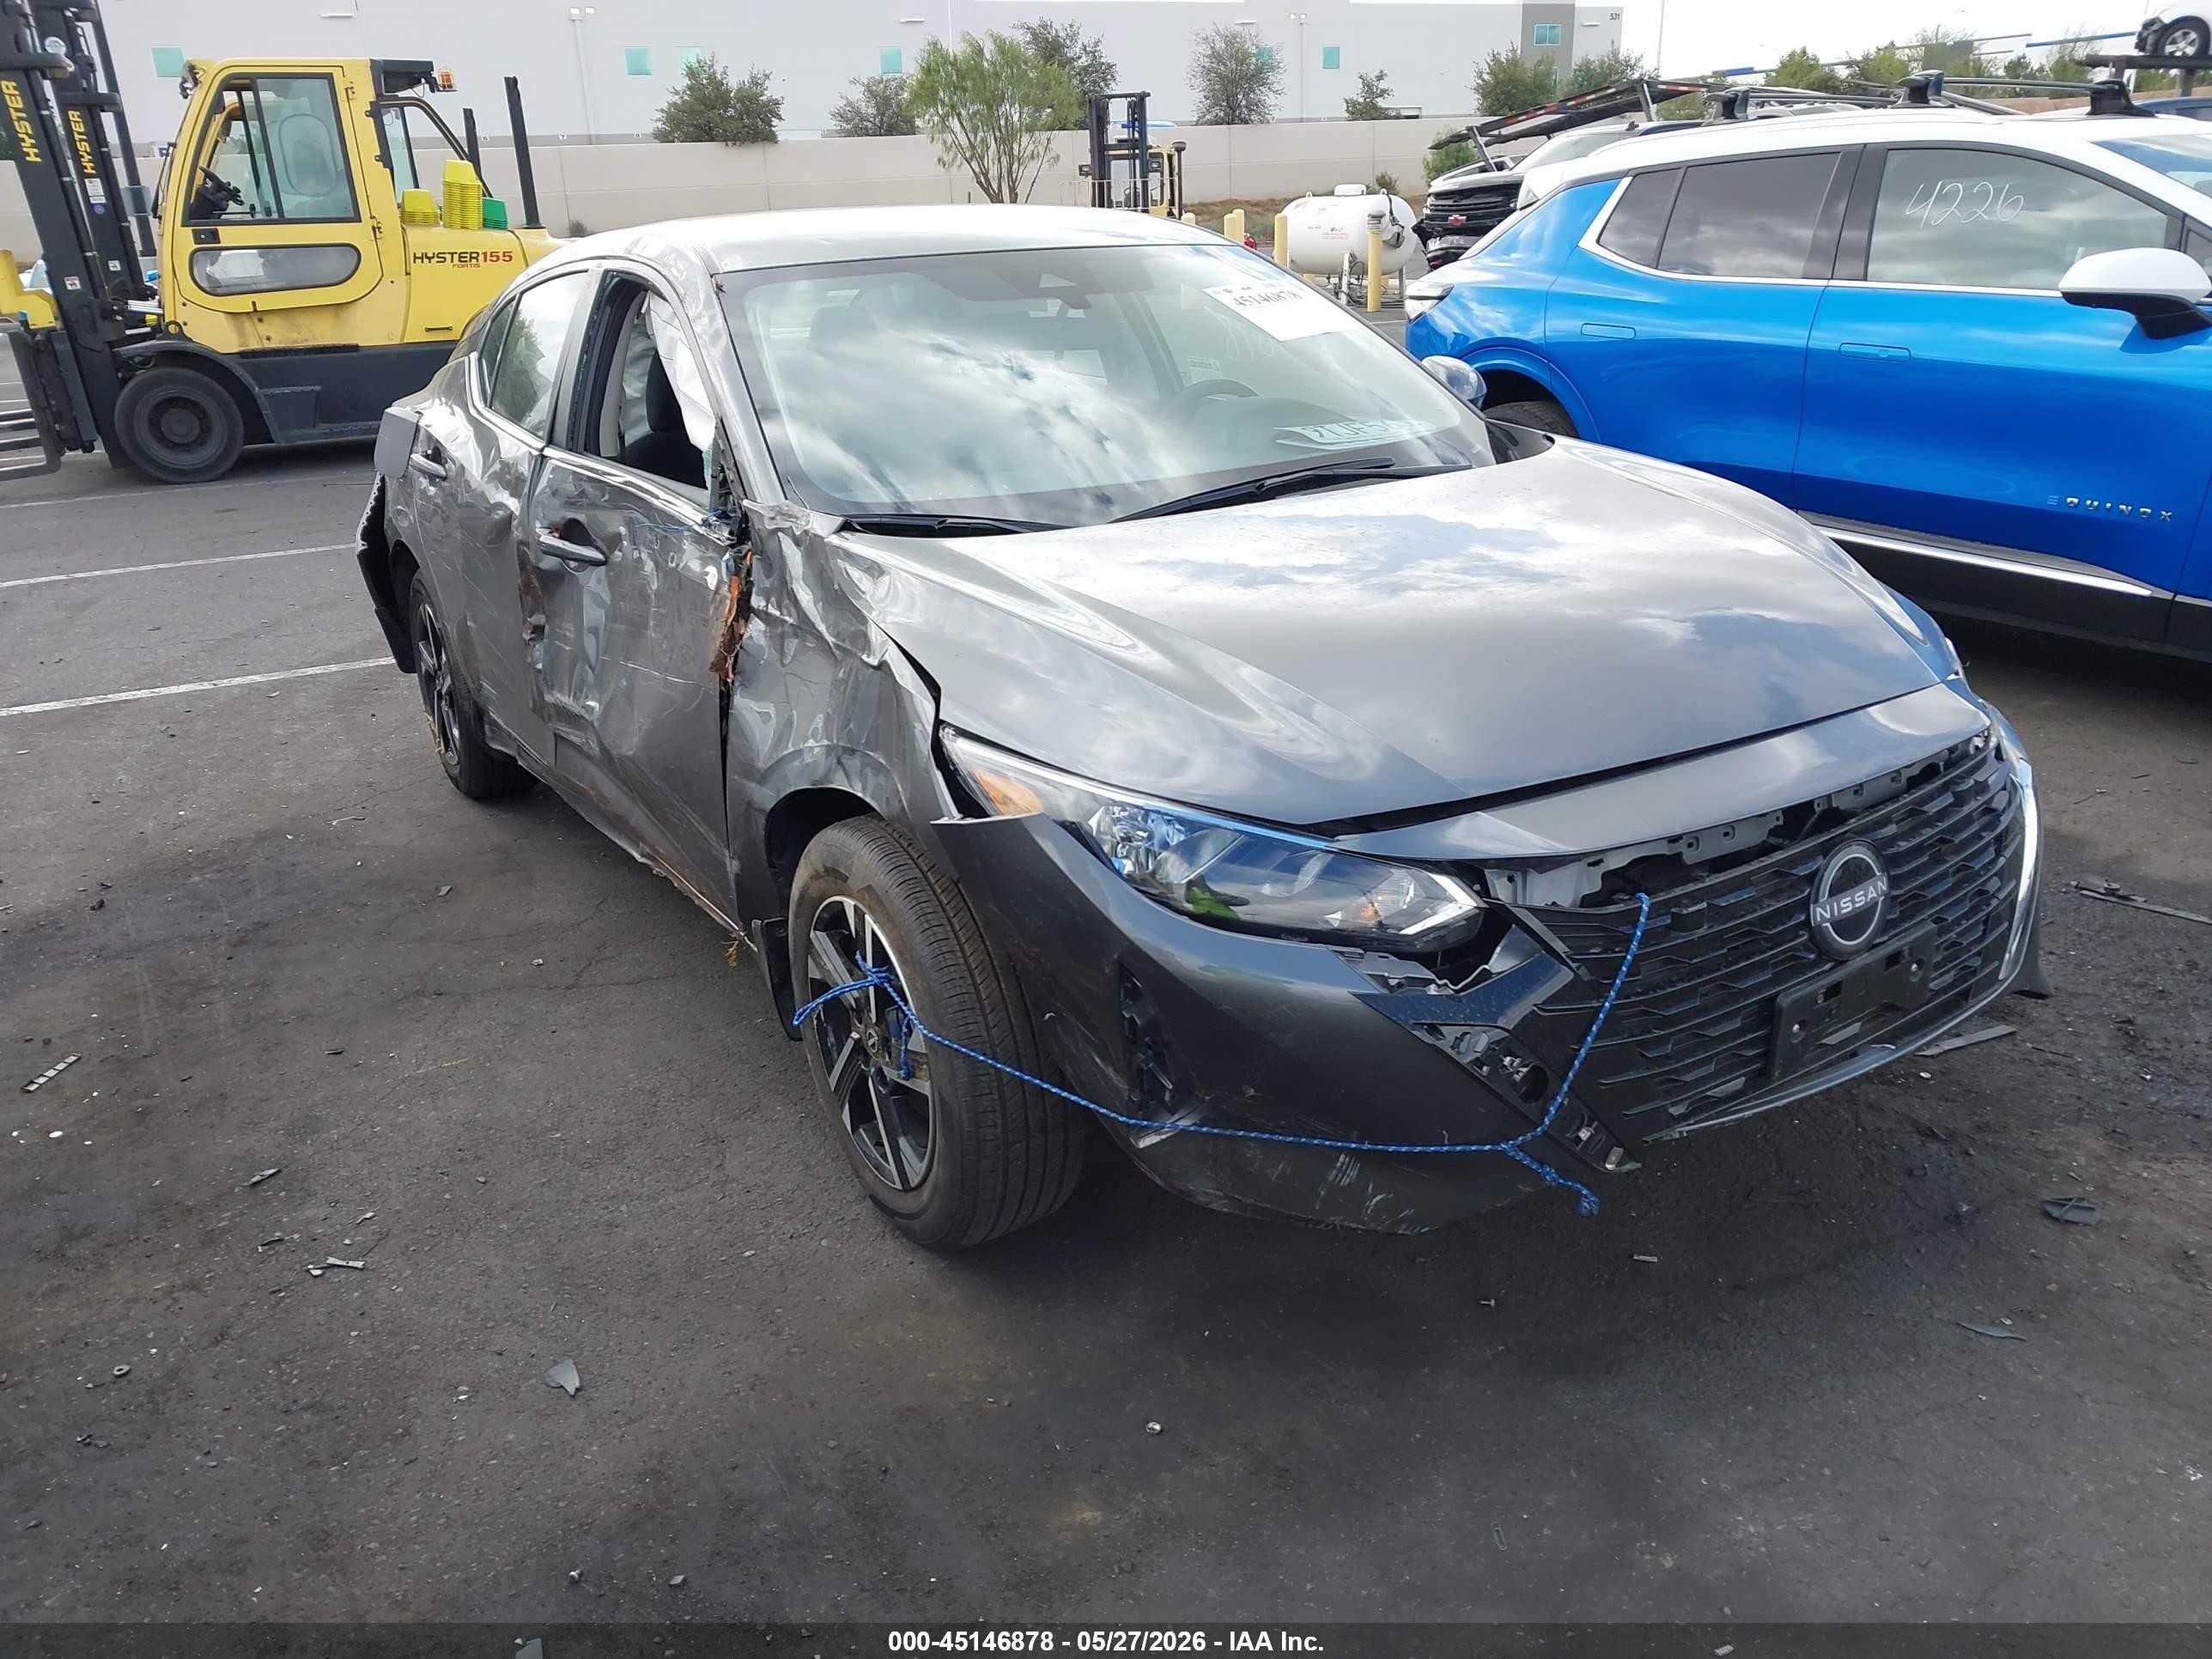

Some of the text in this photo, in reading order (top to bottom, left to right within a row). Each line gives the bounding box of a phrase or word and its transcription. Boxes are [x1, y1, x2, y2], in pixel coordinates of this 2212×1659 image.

[1609, 11, 1621, 21] 531
[0, 79, 42, 163] HYSTER
[67, 109, 97, 175] HYSTER
[1905, 180, 2025, 234] 4226
[412, 251, 514, 264] HYSTER 155
[2046, 495, 2173, 522] EQUINOX
[1815, 877, 1887, 921] NISSAN
